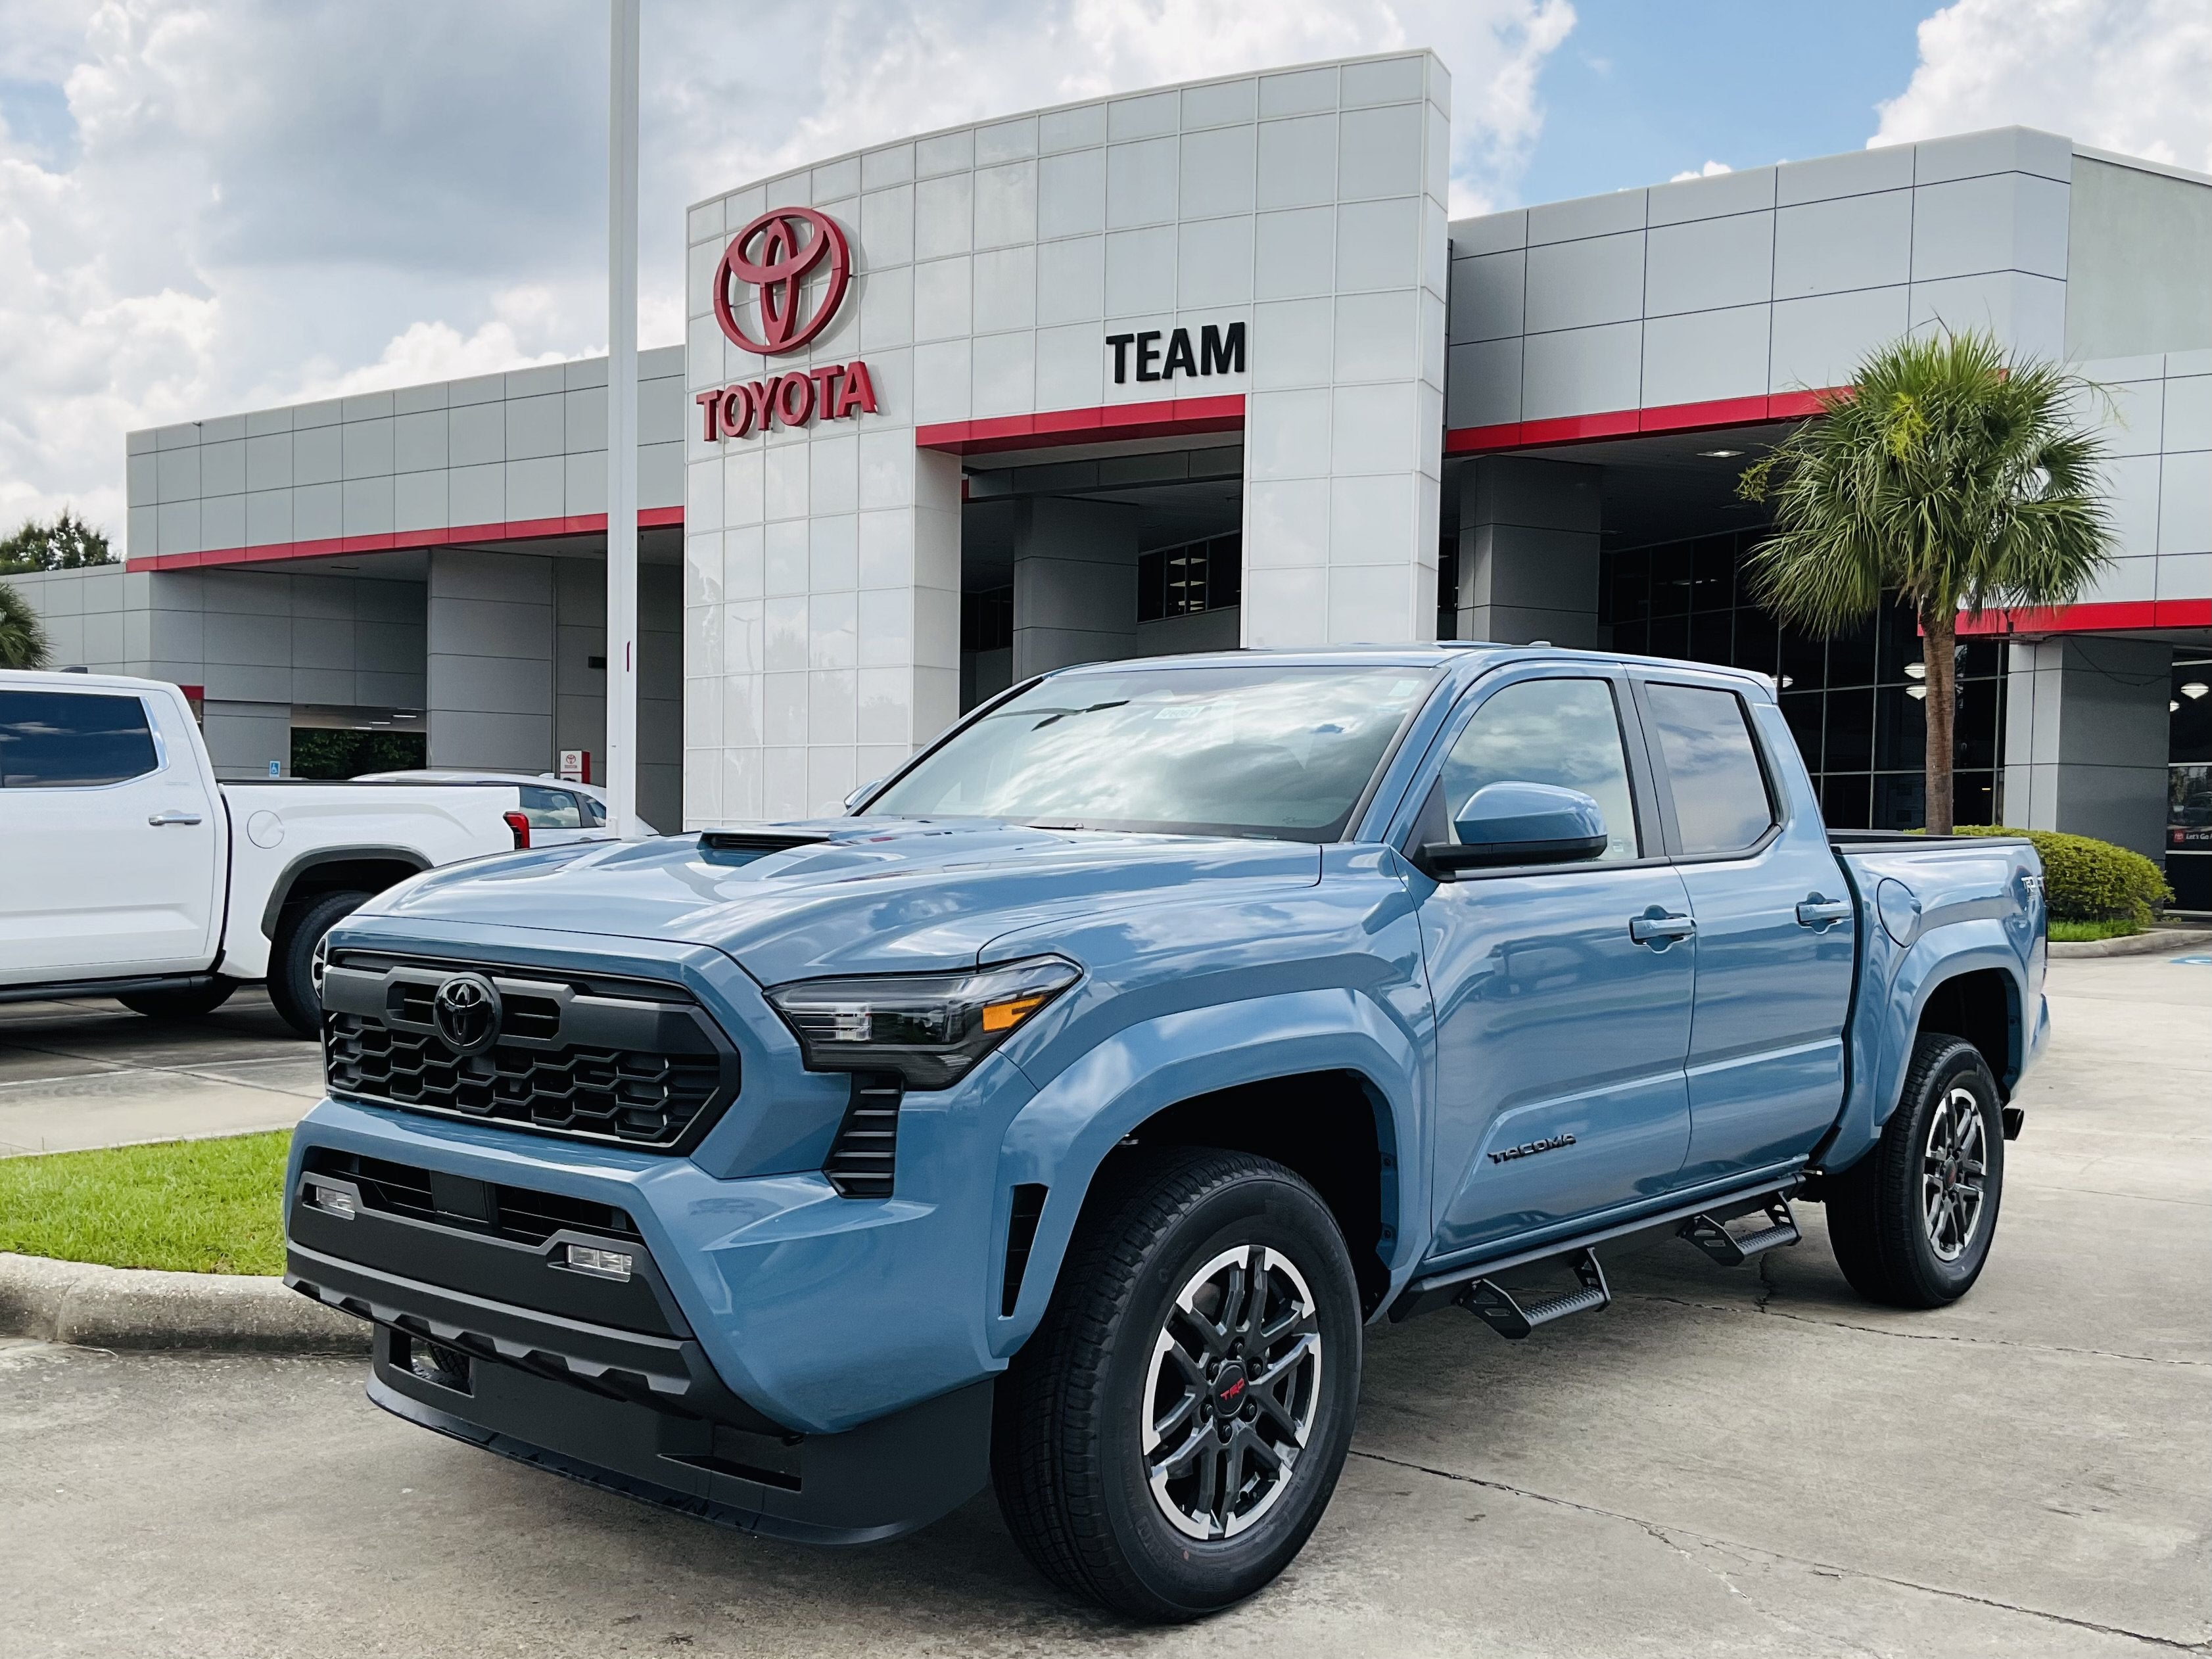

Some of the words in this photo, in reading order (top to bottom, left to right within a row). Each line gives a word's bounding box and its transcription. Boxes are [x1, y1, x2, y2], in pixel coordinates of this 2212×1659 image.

[1106, 321, 1245, 384] TEAM
[696, 360, 877, 442] TOYOTA
[1487, 1133, 1576, 1164] TACOMA
[1220, 1378, 1244, 1400] TRD
